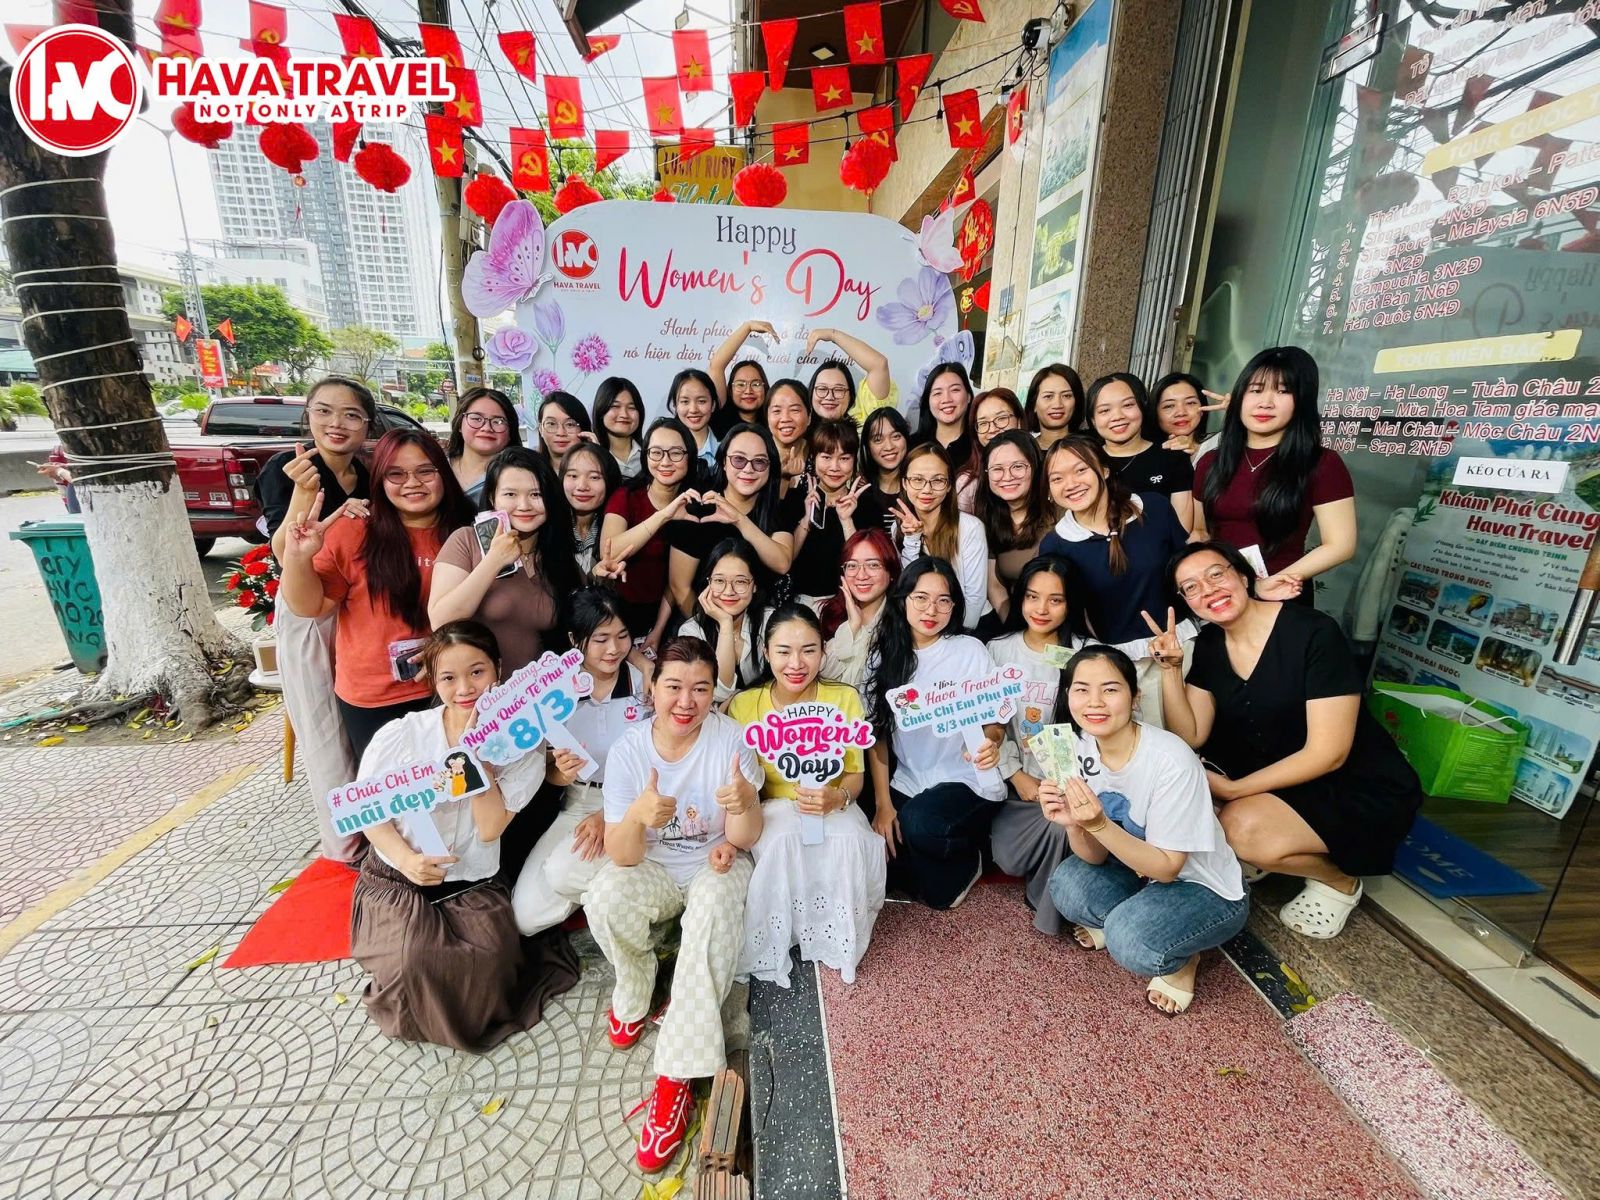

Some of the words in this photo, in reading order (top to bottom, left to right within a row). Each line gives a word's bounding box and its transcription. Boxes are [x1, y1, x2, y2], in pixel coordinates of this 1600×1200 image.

[705, 155, 737, 180] RUBY
[1447, 166, 1524, 204] Bangkok
[715, 215, 800, 255] Happy
[1360, 230, 1433, 264] Singapore
[1448, 208, 1529, 243] Malaysia
[1533, 186, 1599, 222] 6N5Đ
[1365, 214, 1435, 246] Singapore
[1352, 270, 1431, 298] Campuchia
[1432, 256, 1483, 283] 3N2Đ
[1382, 253, 1426, 277] 3N2Đ
[553, 281, 574, 289] HAVA
[575, 282, 601, 290] TRAVEL
[617, 248, 767, 310] Women's
[785, 247, 881, 321] Day
[1414, 279, 1461, 303] 7N6Đ
[1372, 303, 1412, 329] Quốc
[1413, 298, 1461, 322] 5N4Đ
[659, 317, 699, 338] Hạnh
[702, 319, 734, 344] phúc
[623, 344, 640, 359] nó
[644, 343, 672, 361] hiện
[676, 344, 703, 361] diện
[1327, 388, 1344, 402] Hà
[1345, 386, 1370, 402] Nội
[1384, 385, 1405, 401] Hạ
[1407, 383, 1449, 402] Long
[1470, 376, 1518, 399] Tuần
[1522, 376, 1581, 398] Châu
[1321, 403, 1340, 418] Hà
[1342, 402, 1382, 420] Giang
[1395, 402, 1430, 418] Mùa
[1432, 401, 1468, 417] Hoa
[1471, 401, 1510, 418] Tam
[1513, 399, 1560, 422] giác
[1561, 402, 1600, 422] mạ
[1320, 420, 1340, 435] Hà
[1340, 419, 1361, 437] Nội
[1372, 420, 1401, 436] Mai
[1401, 419, 1444, 438] Châu
[1461, 420, 1506, 442] Mộc
[1506, 421, 1563, 443] Châu
[1333, 437, 1356, 453] Nội
[1368, 439, 1406, 455] Sapa
[1409, 439, 1453, 457] 2N1Đ
[1465, 461, 1495, 477] KÉO
[1496, 464, 1527, 480] CỬA
[1530, 469, 1551, 481] RA
[1438, 488, 1491, 513] Khám
[1491, 496, 1535, 519] Phá
[1536, 501, 1600, 533] Cùng
[463, 718, 500, 747] Ngày
[496, 693, 529, 721] Quốc
[525, 676, 542, 699] Tế
[539, 663, 564, 690] Phụ
[561, 652, 582, 670] Nữ
[479, 686, 509, 711] Chúc
[924, 688, 957, 706] Hava
[960, 672, 999, 694] Travel
[508, 688, 575, 750] 8/3
[786, 705, 835, 718] HAPPY
[901, 709, 933, 729] Chúc
[934, 704, 956, 720] Chị
[956, 699, 976, 713] Em
[976, 692, 1002, 706] Phụ
[1002, 682, 1022, 698] Nữ
[936, 719, 958, 735] 8/3
[958, 713, 980, 727] vui
[980, 706, 996, 722] vẻ
[745, 713, 873, 757] Women's
[777, 752, 841, 783] Day
[345, 780, 384, 804] Chúc
[384, 770, 411, 791] Chị
[411, 764, 437, 783] Em
[334, 803, 386, 835] mãi
[389, 786, 437, 813] đẹp
